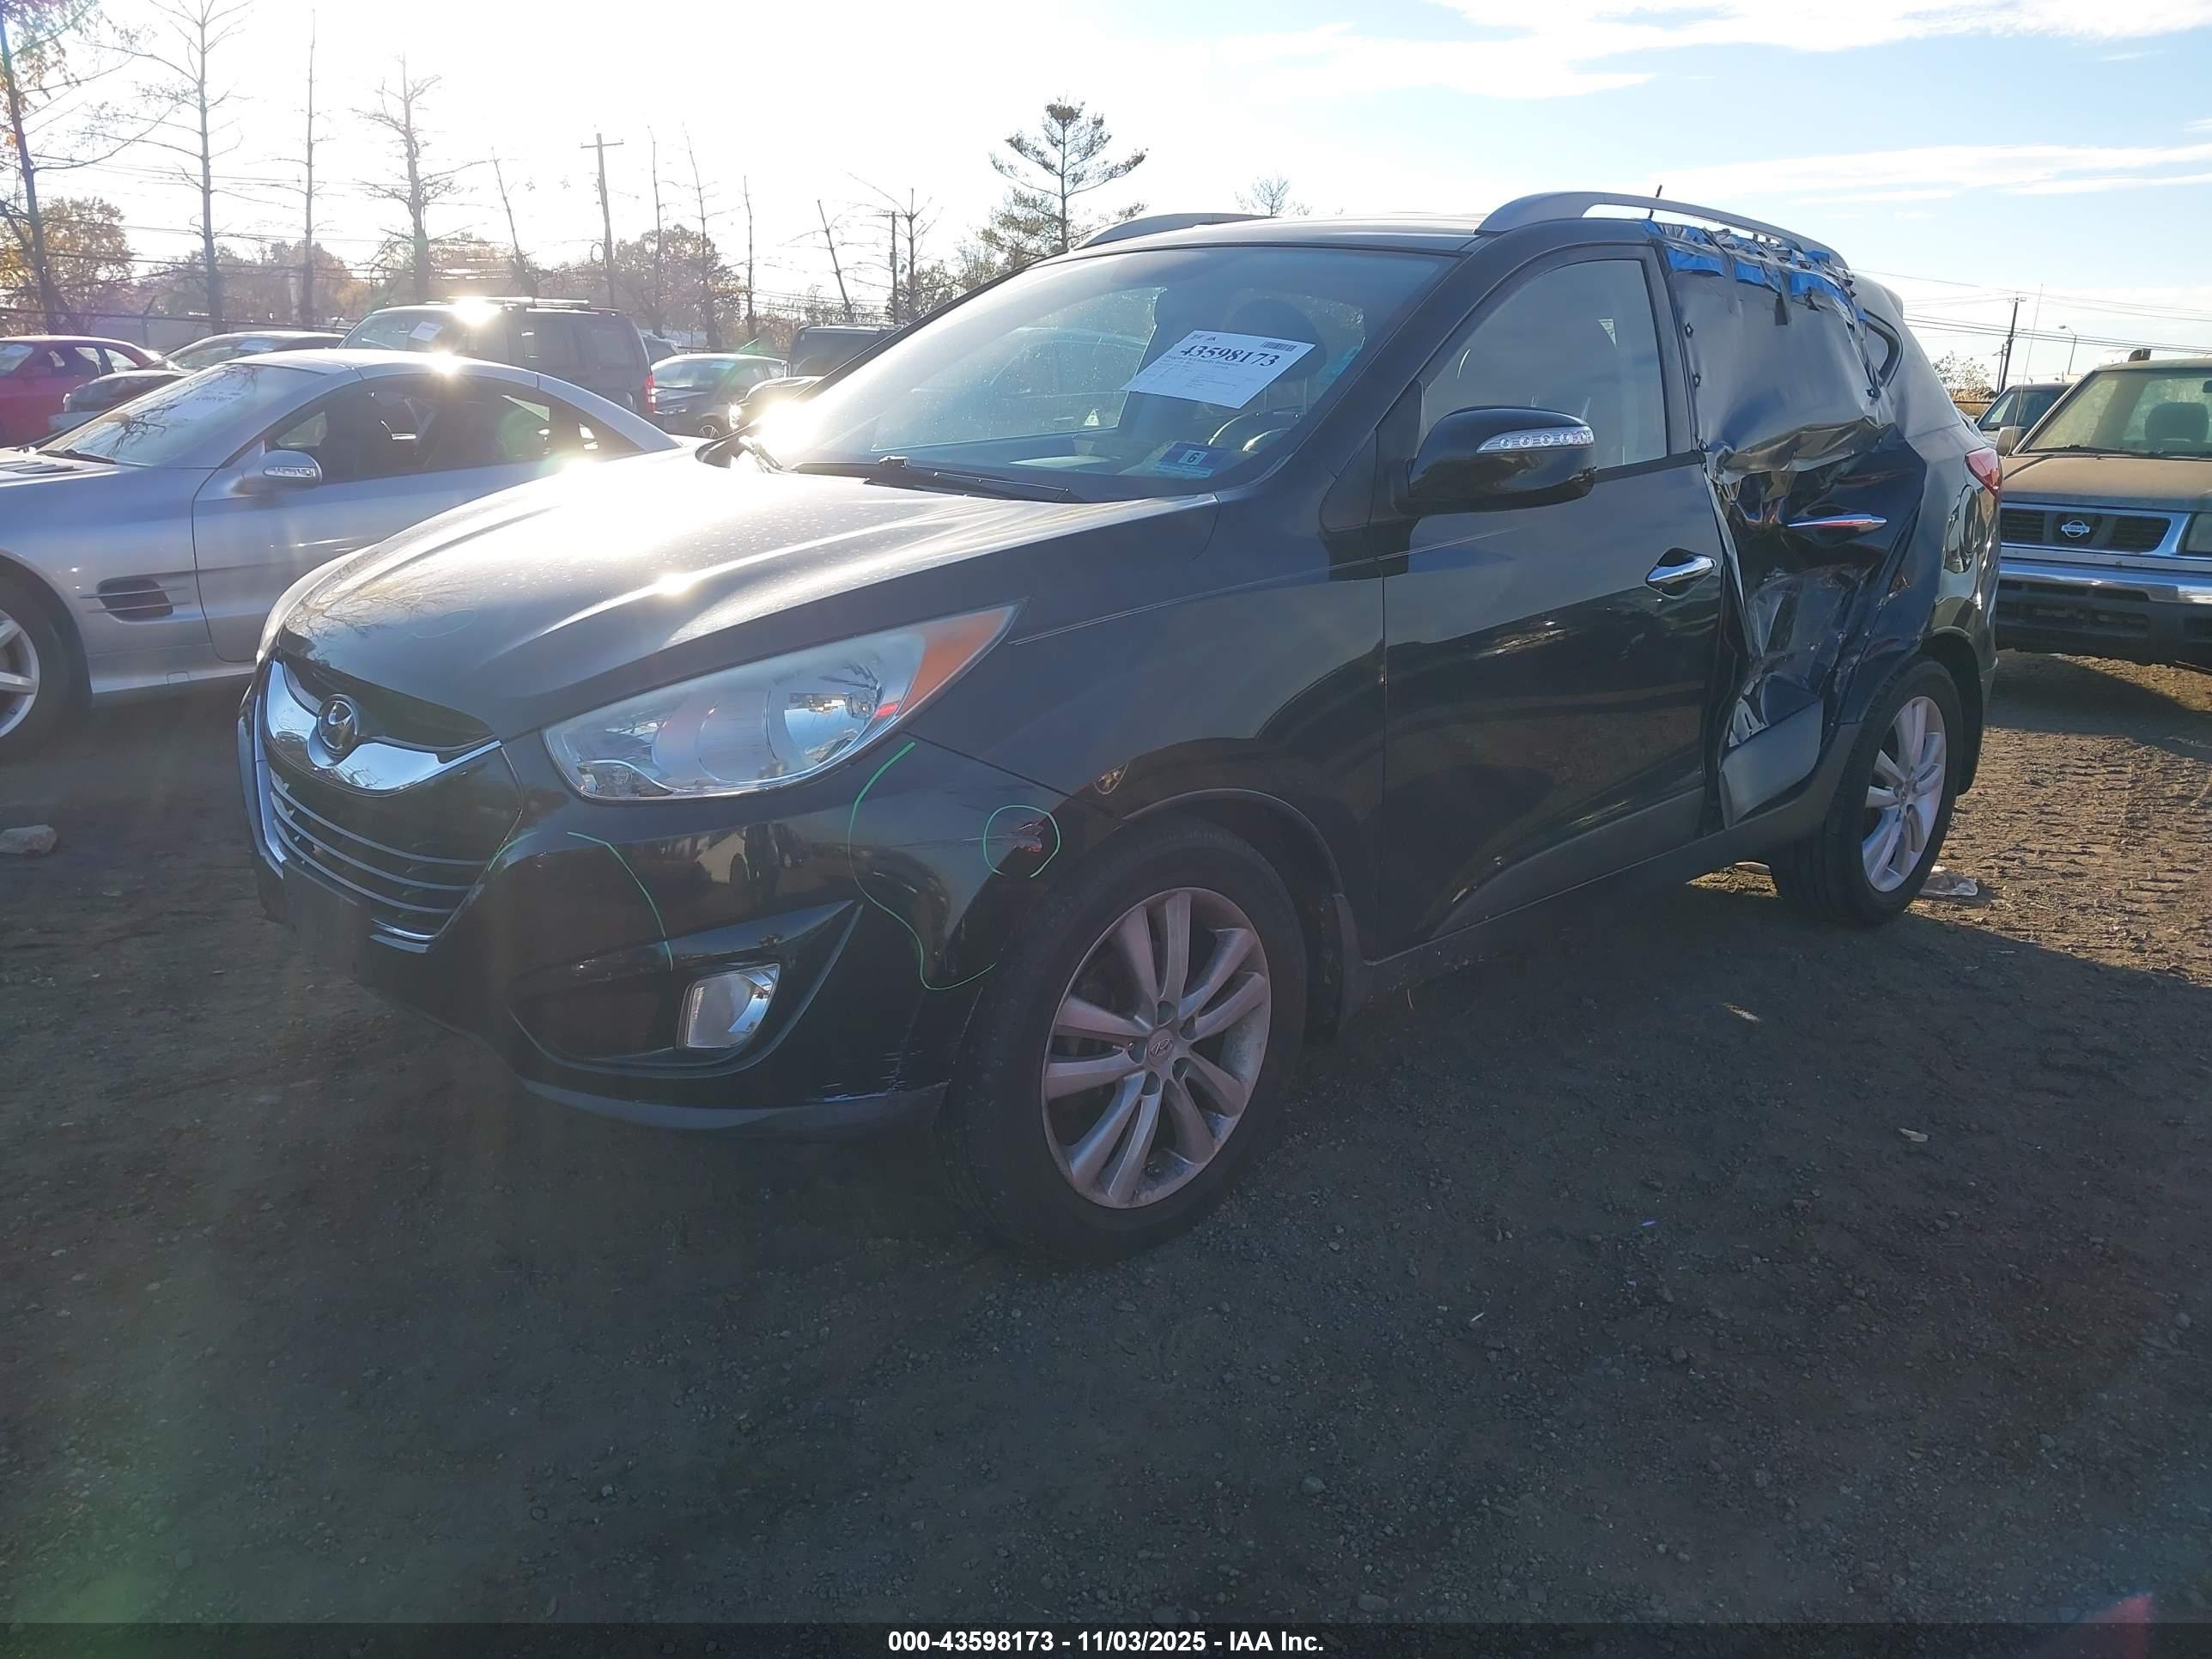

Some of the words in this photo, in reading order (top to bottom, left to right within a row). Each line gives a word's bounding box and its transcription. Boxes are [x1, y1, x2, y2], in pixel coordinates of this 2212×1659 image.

[1180, 344, 1280, 367] 43598173
[1187, 452, 1200, 464] 6
[2062, 525, 2090, 533] NISSAN
